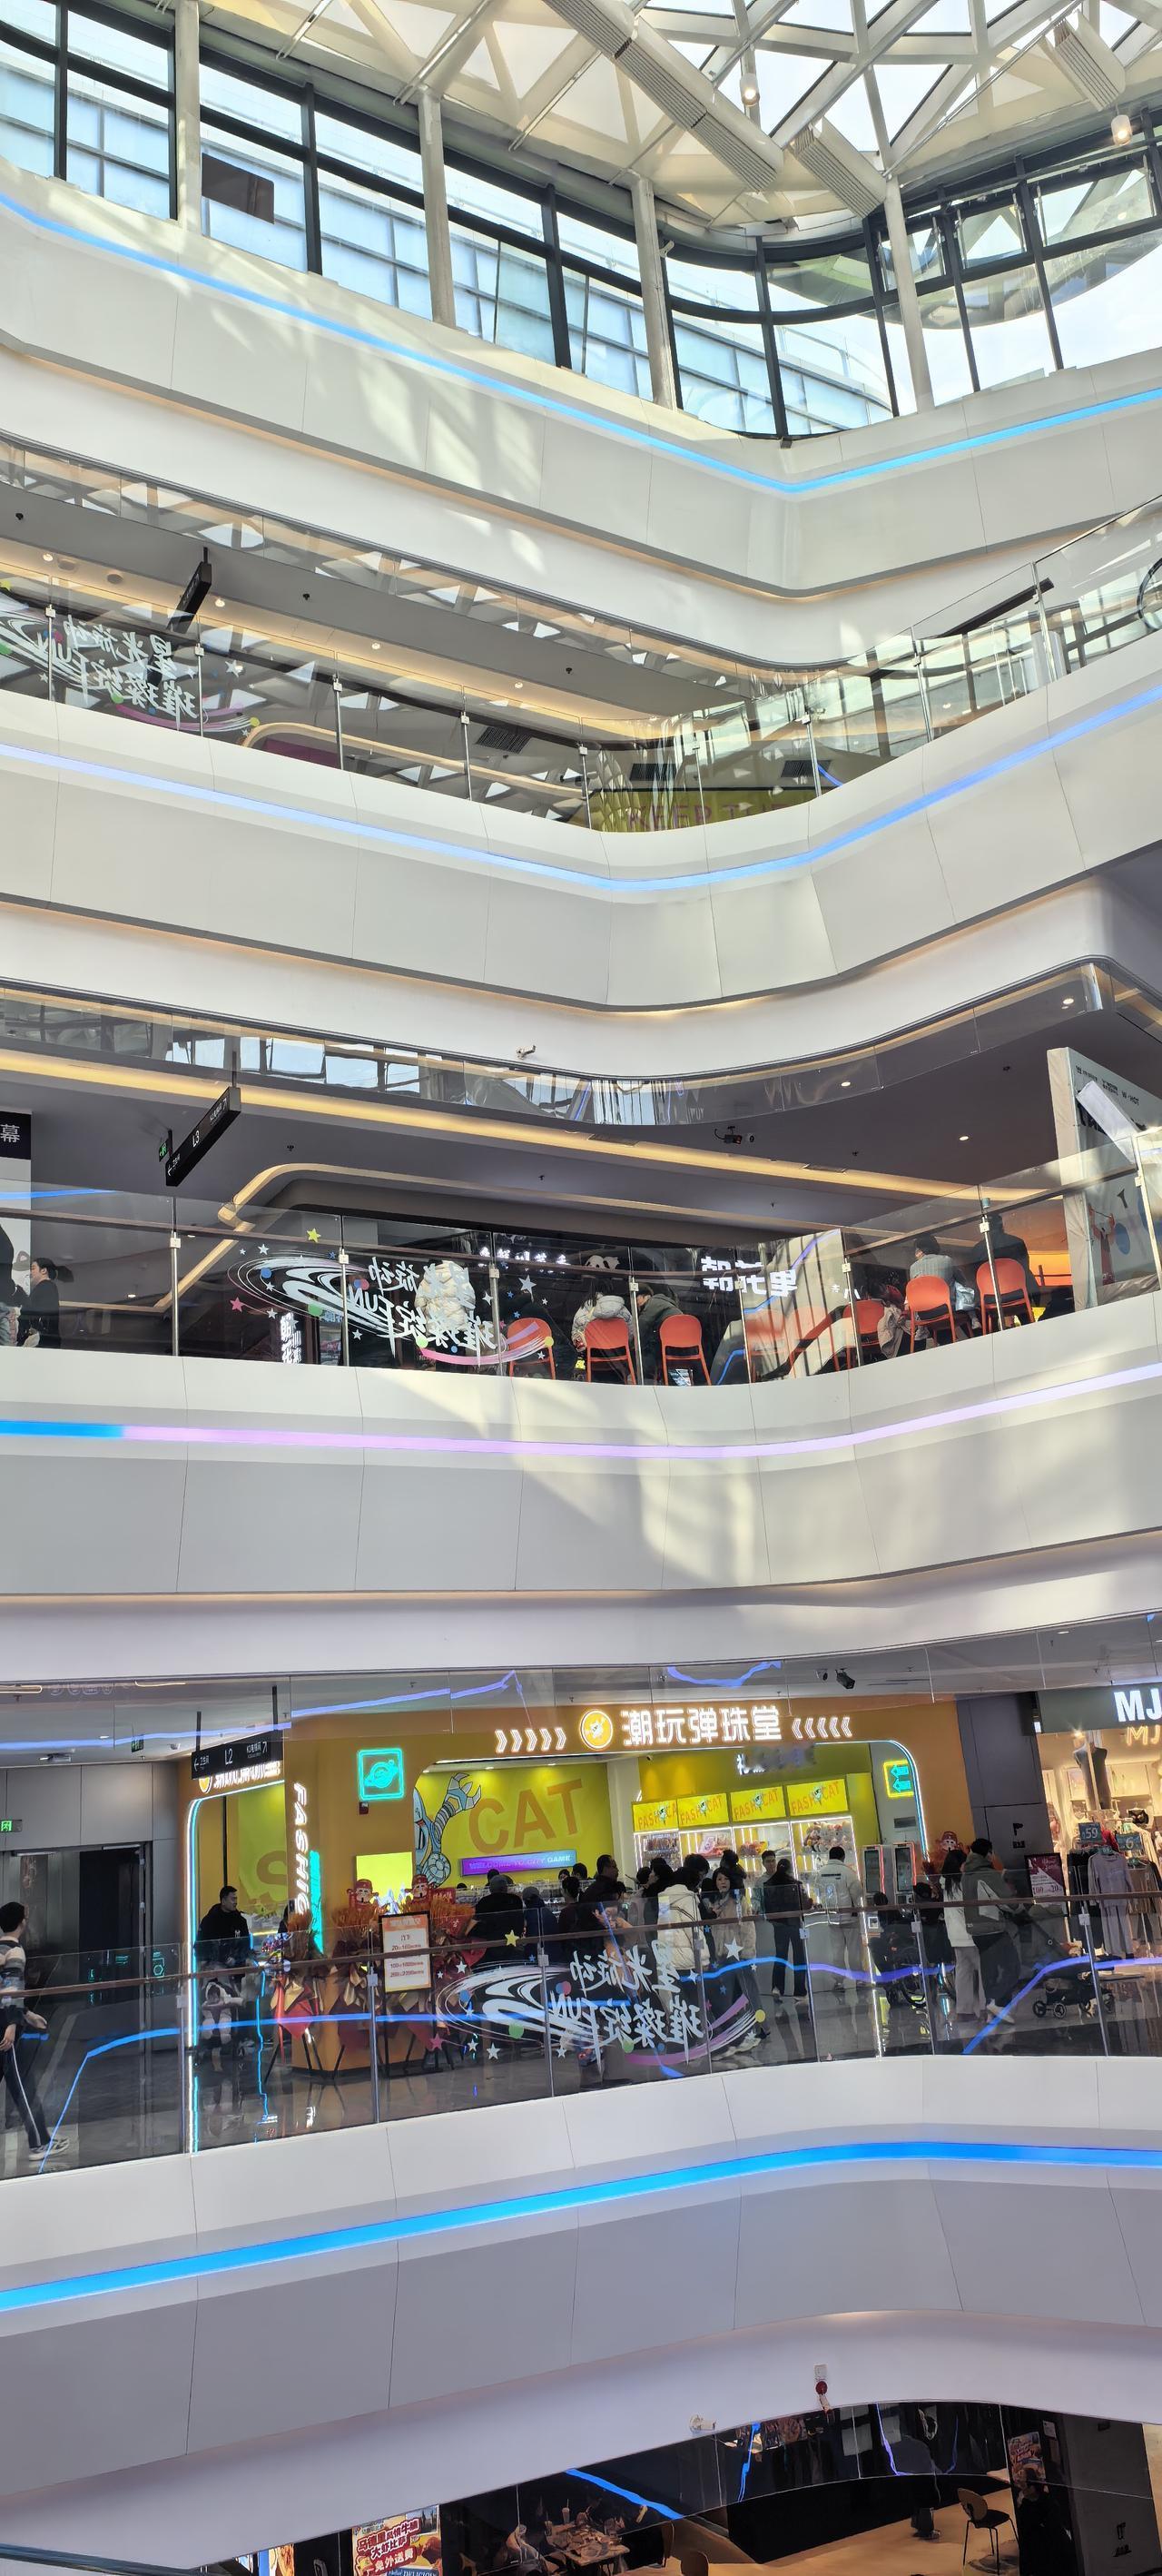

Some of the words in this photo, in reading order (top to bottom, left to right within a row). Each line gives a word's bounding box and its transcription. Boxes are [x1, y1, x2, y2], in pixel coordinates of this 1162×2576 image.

[192, 1130, 200, 1147] L3
[620, 1704, 783, 1746] 潮玩弹珠堂
[224, 1748, 233, 1765] L2
[468, 1778, 583, 1854] CAT
[547, 1855, 571, 1864] GAME
